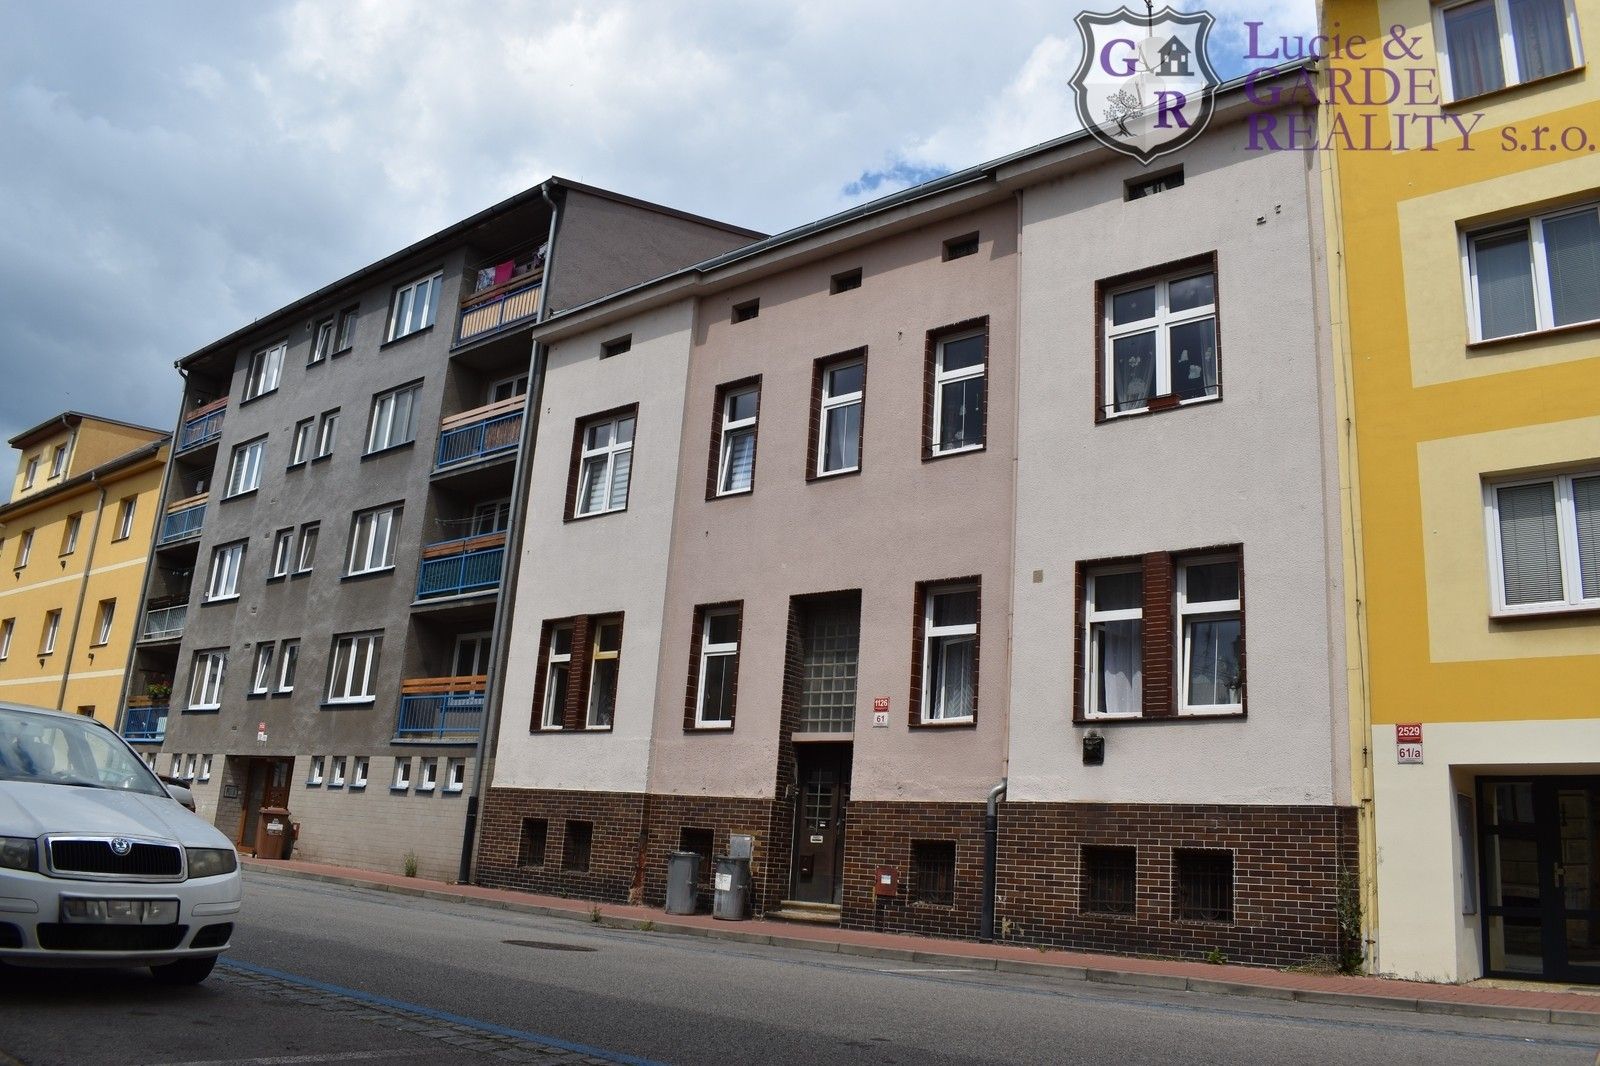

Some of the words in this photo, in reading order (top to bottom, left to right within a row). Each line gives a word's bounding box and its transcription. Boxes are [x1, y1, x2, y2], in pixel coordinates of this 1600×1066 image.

[874, 699, 888, 707] 1126
[876, 715, 885, 723] 61
[1398, 726, 1420, 736] 2529
[1399, 748, 1421, 758] 61/a
